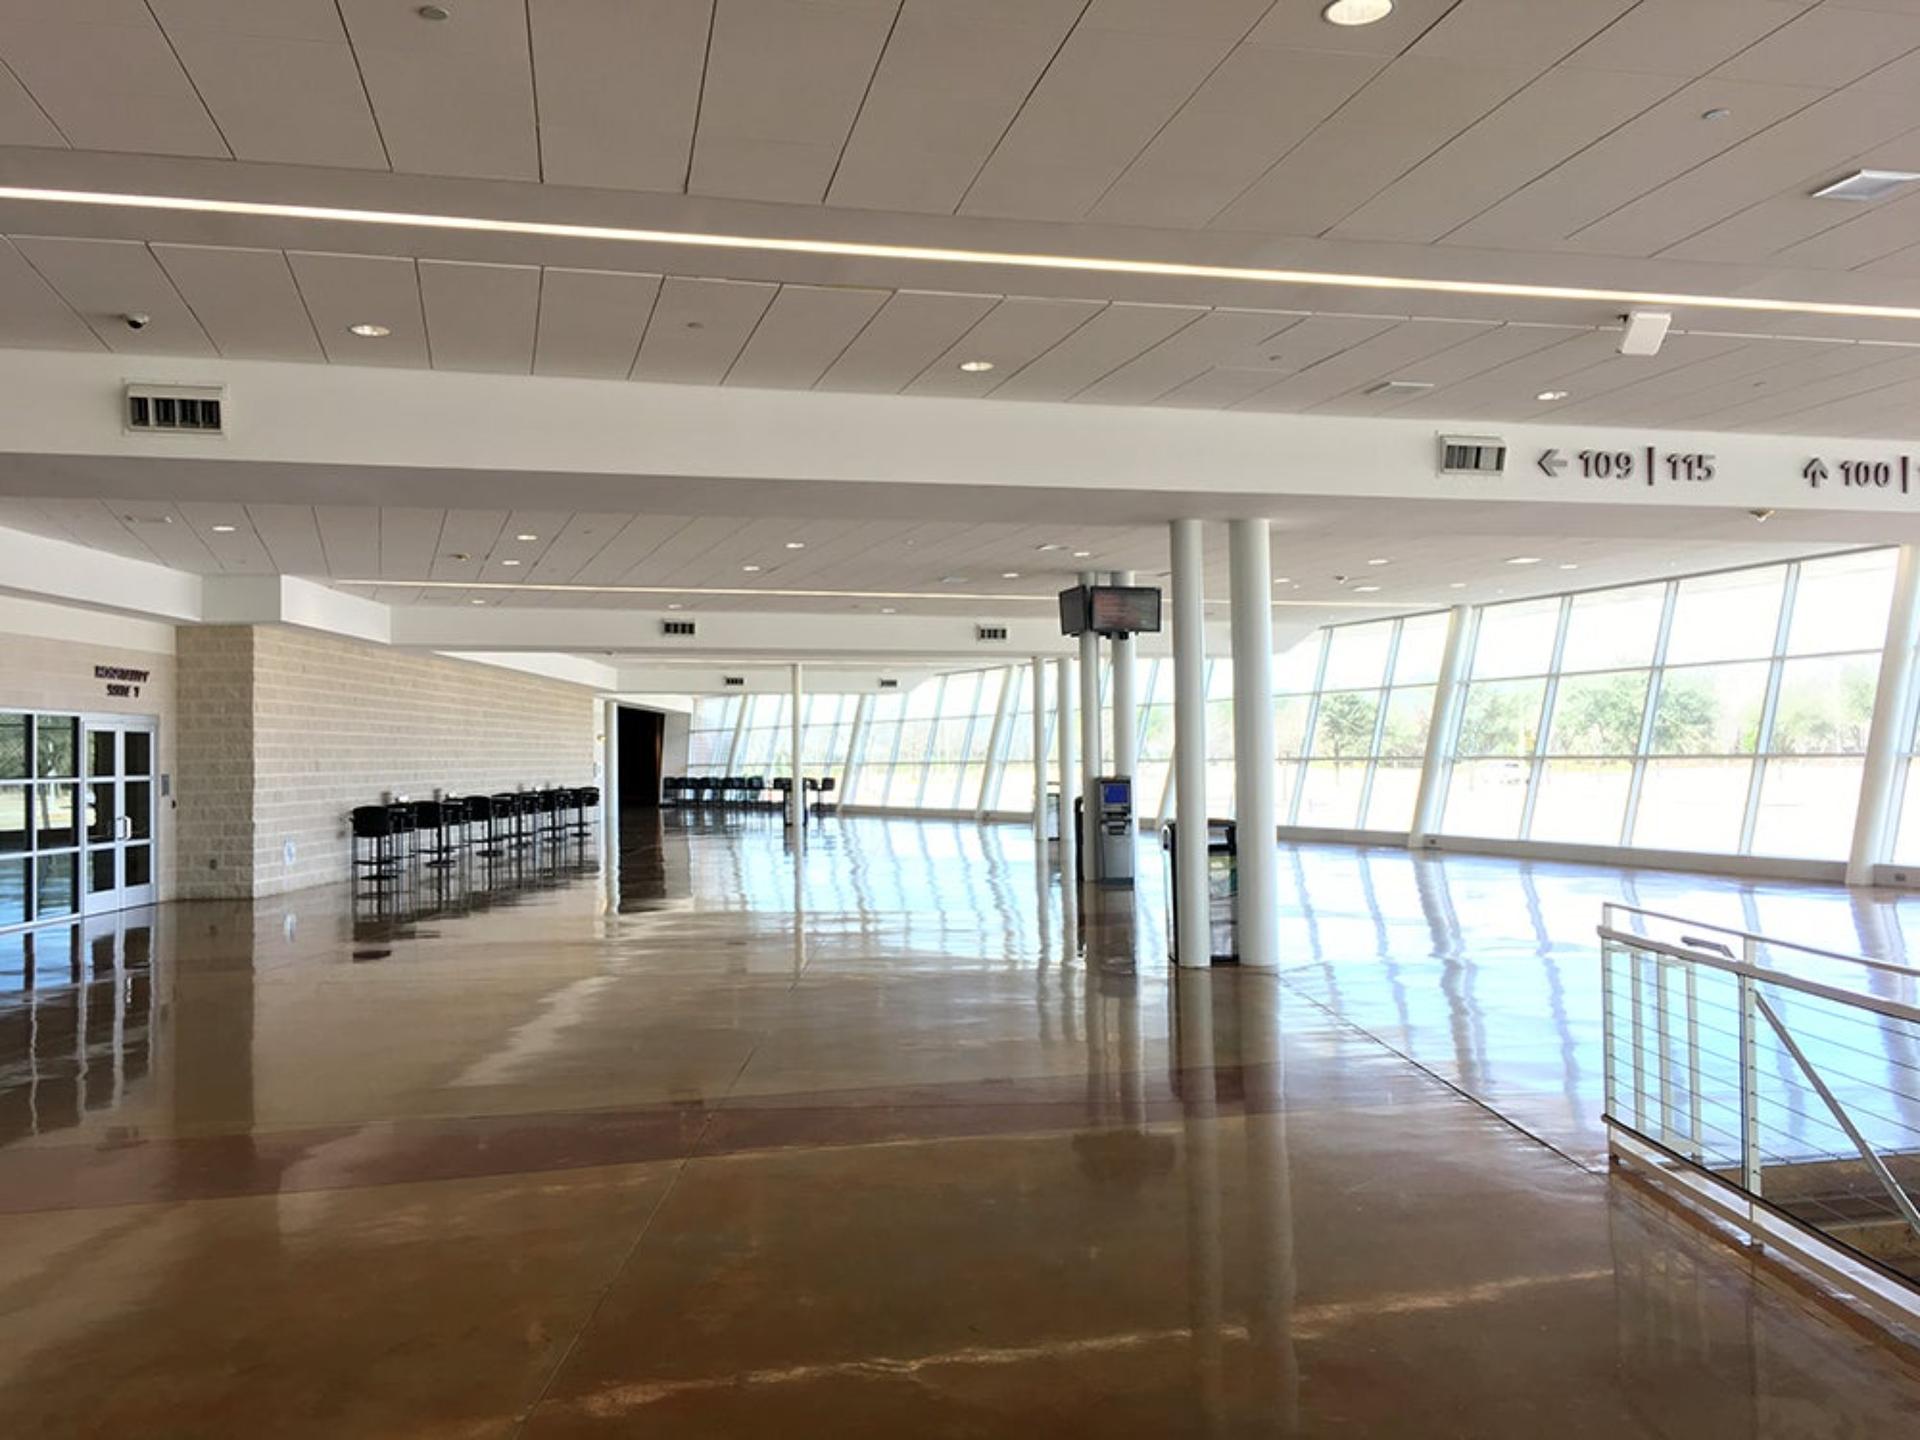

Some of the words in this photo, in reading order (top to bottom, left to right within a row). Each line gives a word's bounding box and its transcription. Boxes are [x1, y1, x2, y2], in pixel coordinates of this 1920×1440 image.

[1579, 449, 1633, 479] 109
[1666, 453, 1716, 481] 115
[1839, 460, 1890, 487] 100
